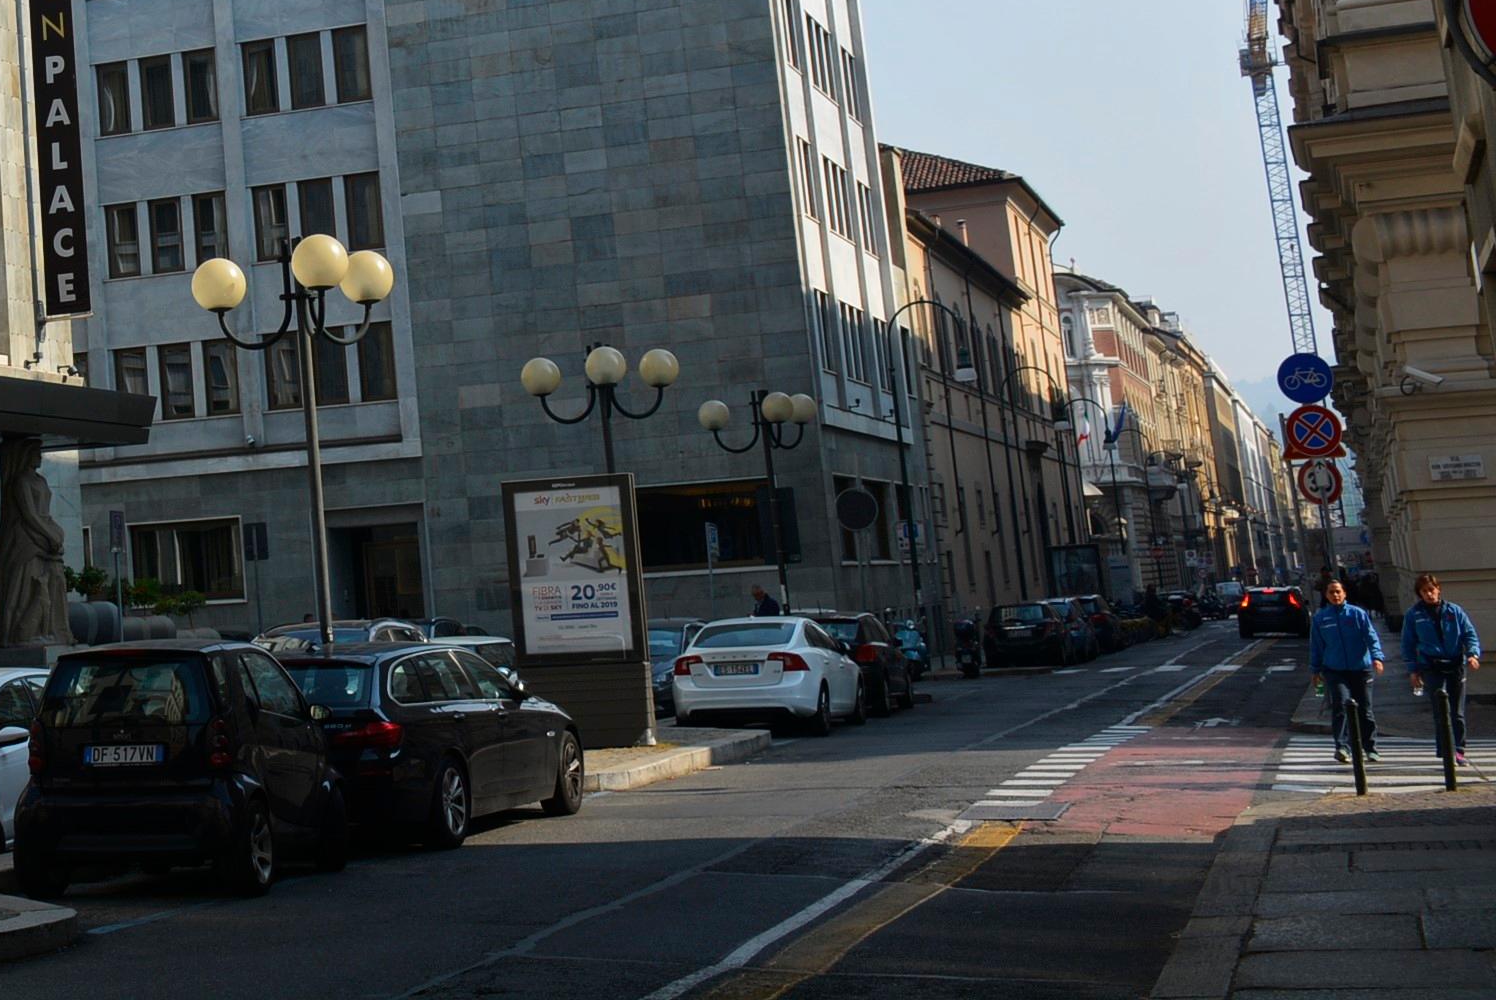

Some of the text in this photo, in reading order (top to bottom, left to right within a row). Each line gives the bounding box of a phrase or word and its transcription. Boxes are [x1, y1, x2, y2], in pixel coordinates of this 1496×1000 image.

[45, 55, 77, 304] PALACE
[534, 495, 550, 506] sky
[532, 586, 561, 596] FIBRA
[93, 746, 154, 761] DF 517VN
